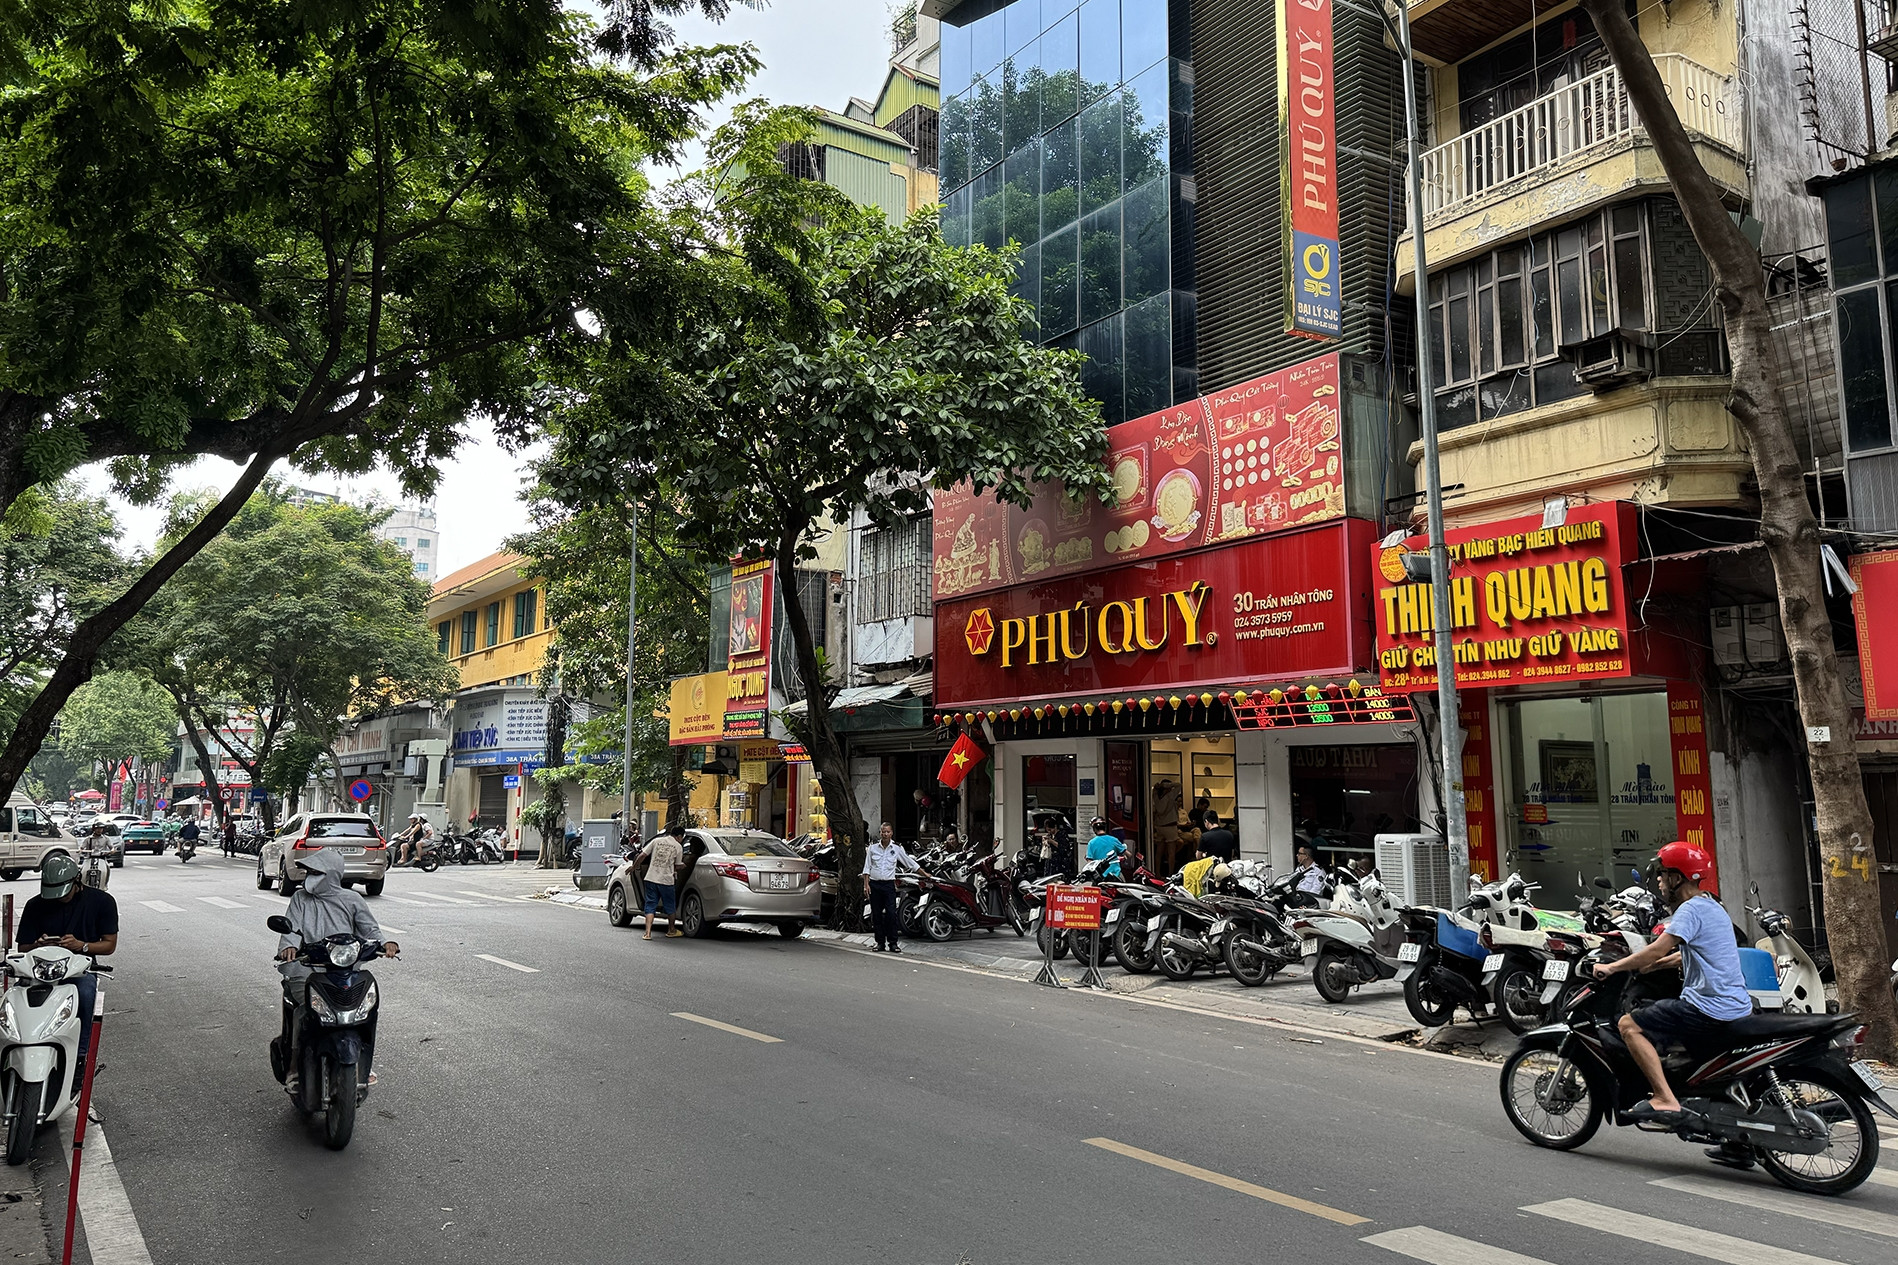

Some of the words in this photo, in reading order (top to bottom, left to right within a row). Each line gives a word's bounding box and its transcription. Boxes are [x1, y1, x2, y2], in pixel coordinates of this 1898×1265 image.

[1296, 26, 1323, 117] QUÝ
[1298, 124, 1327, 213] PHÚ
[1312, 304, 1321, 317] LÝ
[1323, 308, 1339, 321] SJC
[1464, 538, 1496, 560] VÀNG
[1498, 534, 1522, 555] BẠC
[1558, 520, 1602, 545] QUANG
[1233, 591, 1253, 613] 30
[1254, 594, 1278, 611] TRẦN
[1280, 592, 1306, 607] NHÂN
[1307, 588, 1333, 603] TÔNG
[1485, 557, 1609, 628] QUANG
[1000, 600, 1089, 668] PHÚ
[1098, 580, 1213, 654] QUÝ
[1234, 617, 1249, 628] 024
[1250, 613, 1271, 626] 3573
[1271, 611, 1293, 624] 5959
[1235, 621, 1324, 640] www.phuquy.com.vn
[1381, 644, 1408, 669] GIỮ
[1452, 638, 1481, 663] TÍN
[1484, 640, 1523, 661] NHƯ
[1528, 632, 1562, 657] GIỮ
[1568, 626, 1619, 653] VÀNG
[1523, 666, 1535, 677] 024
[1536, 664, 1554, 676] 3944
[1594, 660, 1608, 671] 852
[1254, 707, 1269, 717] SJC
[1671, 699, 1689, 710] CÔNG
[1690, 700, 1699, 709] TY
[484, 722, 498, 747] XÚC
[1678, 745, 1700, 775] KÍNH
[1681, 785, 1705, 815] CHÀO
[1469, 820, 1482, 849] QUÝ
[1850, 832, 1868, 852] 2
[1829, 855, 1869, 882] 24
[1732, 1042, 1782, 1054] BLADE
